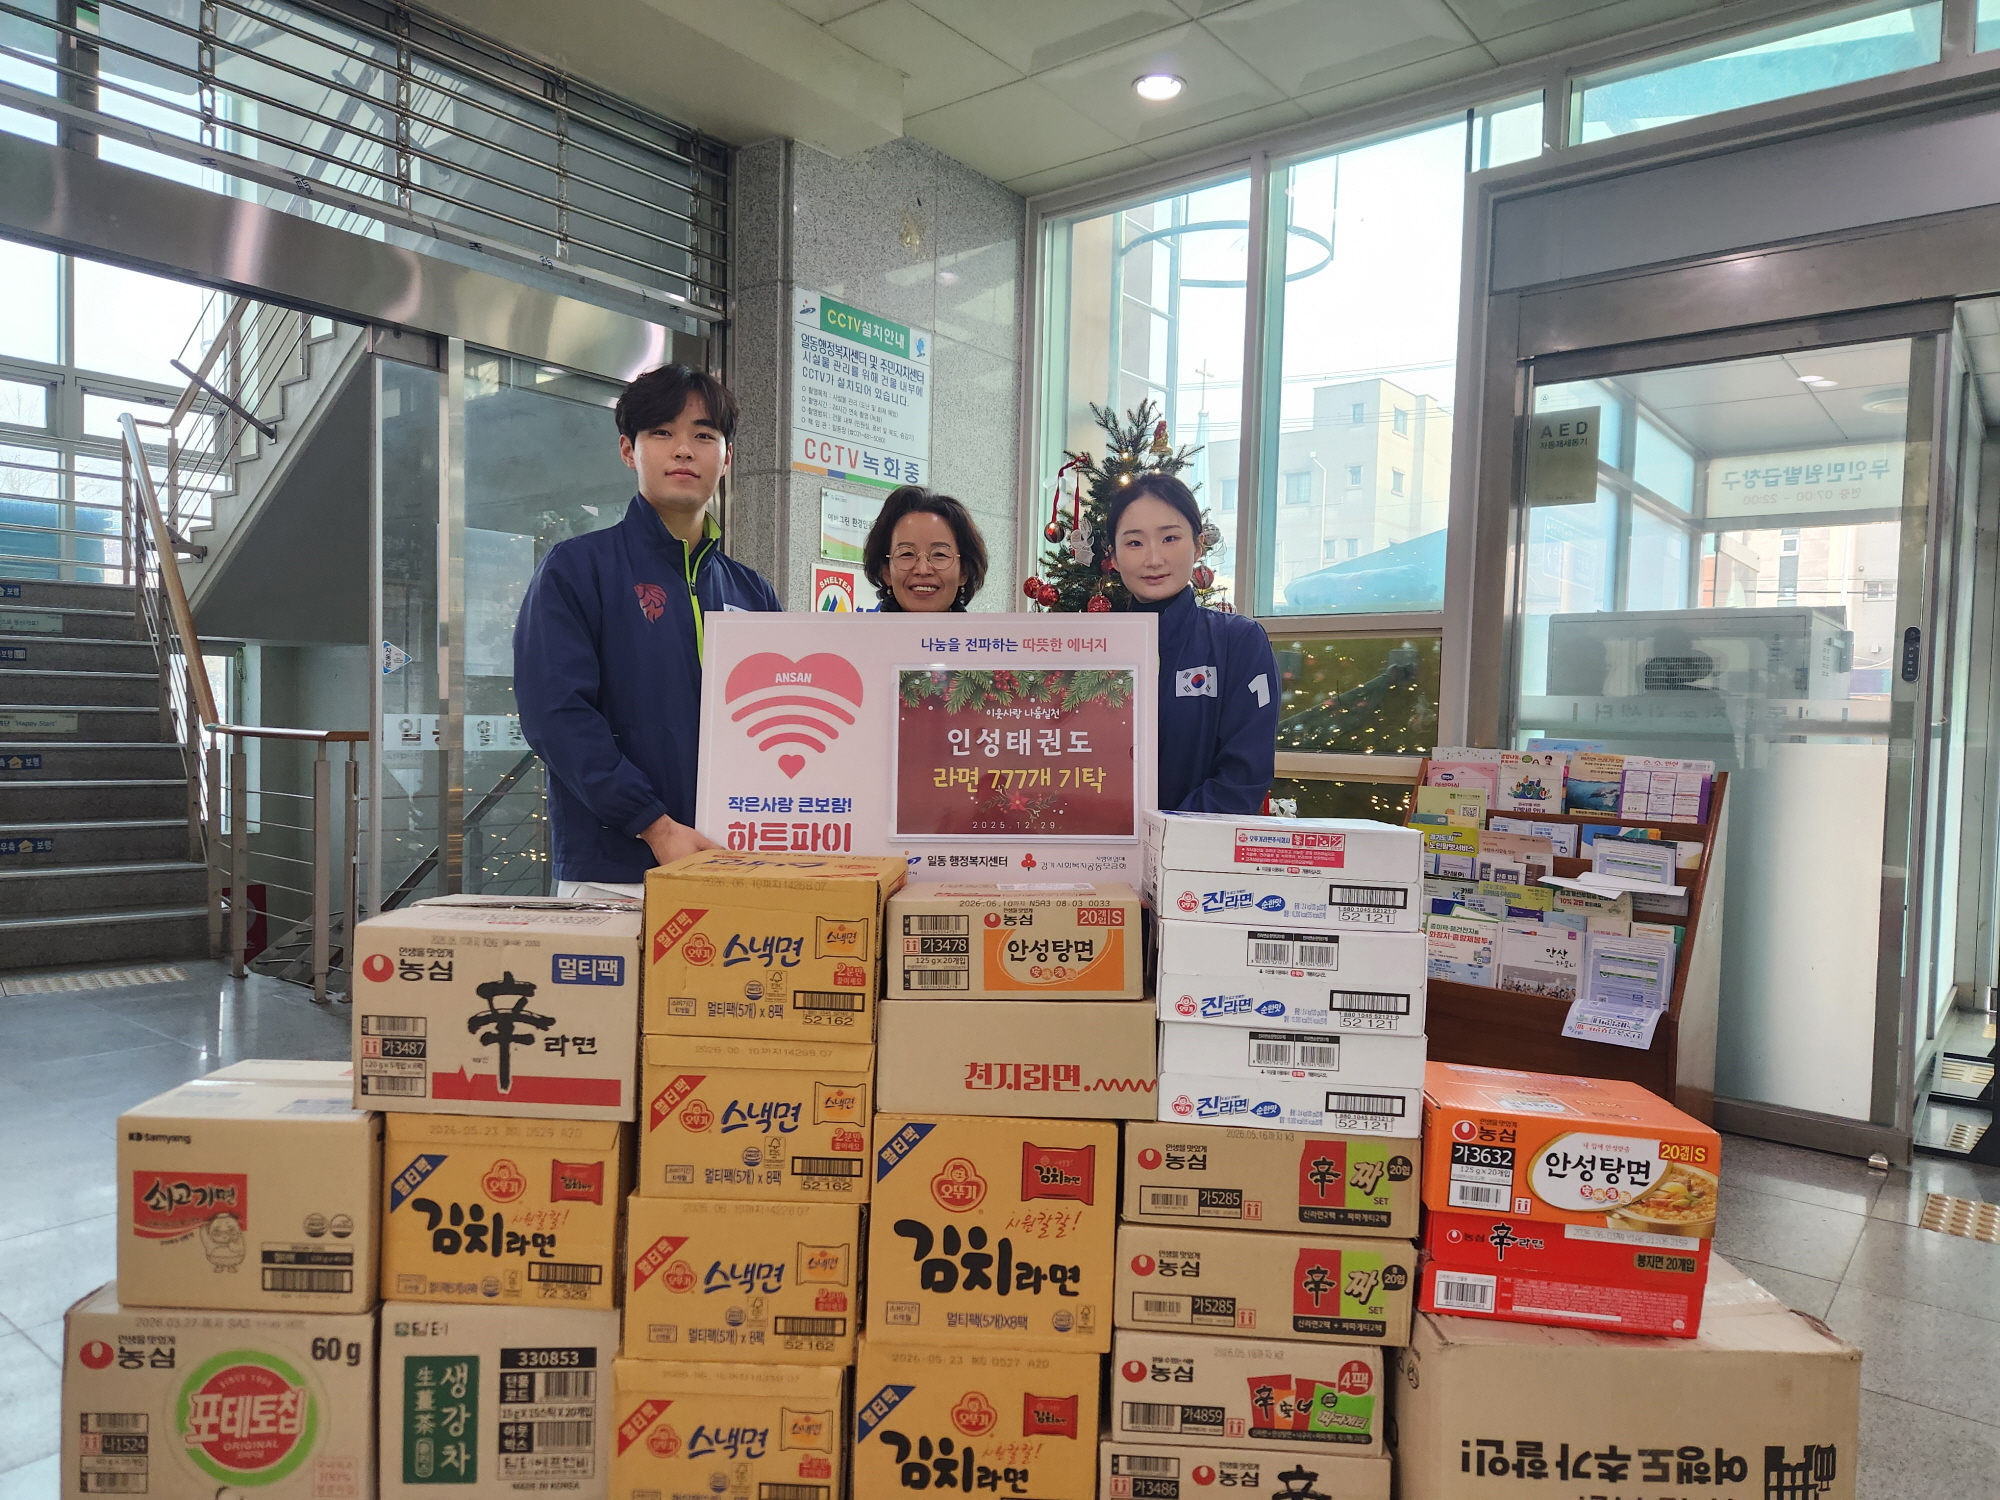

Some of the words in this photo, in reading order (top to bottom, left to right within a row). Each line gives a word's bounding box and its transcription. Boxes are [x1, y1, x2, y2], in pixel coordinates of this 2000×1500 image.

[827, 309, 905, 349] CCTV설치안내
[801, 333, 867, 366] 일동행정복지센터
[870, 357, 878, 370] 및
[880, 358, 924, 385] 주민자치센터
[803, 352, 830, 369] 시설물
[833, 360, 858, 377] 관리를
[862, 369, 878, 382] 위해
[881, 375, 897, 390] 건물
[900, 380, 923, 397] 내부에
[802, 367, 834, 385] CCTV가
[837, 376, 872, 396] 설치되어
[874, 391, 909, 407] 있습니다.
[804, 438, 859, 469] CCTV
[827, 512, 850, 526] 에버그린
[819, 576, 852, 594] SHELTER
[921, 638, 961, 652] 나눔을
[965, 638, 1018, 652] 전파하는
[1023, 638, 1063, 652] 따뜻한
[1067, 638, 1107, 652] 에너지
[775, 672, 812, 684] ANSAN
[1248, 673, 1271, 708] 1
[986, 708, 1022, 720] 이웃사랑
[948, 728, 1093, 758] 인성태권도
[933, 766, 980, 793] 라면
[987, 767, 1051, 789] 777개
[1059, 766, 1106, 794] 기탁
[728, 796, 794, 813] 작은사랑
[798, 797, 852, 813] 큰보람!
[728, 821, 851, 852] 하트파이
[927, 856, 947, 867] 일동
[949, 855, 1008, 868] 행정복지센터
[1202, 888, 1254, 914] 진라면
[1261, 898, 1283, 909] 순한맛
[1003, 914, 1033, 926] 농심
[1341, 912, 1360, 921] 52
[1366, 914, 1391, 922] 121
[656, 912, 693, 949] 멀티팩
[826, 930, 858, 945] 스낵면
[687, 947, 711, 960] 오뚜기
[723, 934, 804, 968] 스낵면
[923, 938, 967, 953] 가3478
[1007, 939, 1094, 963] 안성탕면
[1546, 947, 1568, 960] 안산
[398, 958, 453, 982] 농심
[558, 958, 619, 982] 멀티팩
[707, 1001, 757, 1018] 멀티팩(5개)
[768, 1004, 784, 1019] 8팩
[1200, 993, 1253, 1018] 진라면
[1261, 1003, 1283, 1014] 순한맛
[468, 971, 556, 1091] 辛
[383, 1041, 426, 1056] 가3487
[544, 1035, 597, 1057] 라면
[655, 1078, 691, 1116] 멀티팩
[1196, 1094, 1248, 1118] 진라면
[685, 1114, 708, 1126] 오뚜기
[721, 1100, 802, 1134] 스낵면
[1256, 1104, 1278, 1116] 순한맛
[881, 1126, 920, 1166] 멀티팩
[1479, 1127, 1516, 1143] 농심
[1165, 1152, 1207, 1170] 농심
[1454, 1145, 1513, 1166] 가3632
[394, 1157, 432, 1197] 멀티팩
[705, 1168, 755, 1185] 멀티팩(5개)
[766, 1170, 781, 1186] 8팩
[1035, 1165, 1081, 1186] 김치라면
[1309, 1156, 1342, 1198] 辛
[1350, 1161, 1384, 1196] 짜
[1546, 1152, 1651, 1186] 안성탕면
[143, 1180, 238, 1212] 쇠고기면
[489, 1181, 519, 1194] 오뚜기
[940, 1183, 977, 1199] 오뚜기
[1201, 1191, 1240, 1205] 가5285
[1374, 1197, 1389, 1206] SET
[412, 1198, 555, 1258] 김치라면
[1005, 1206, 1082, 1239] 시원칼칼!
[1464, 1232, 1485, 1243] 농심
[1489, 1223, 1518, 1261] 辛
[1518, 1237, 1545, 1249] 라면
[637, 1239, 673, 1276] 멀티팩
[894, 1219, 1080, 1296] 김치라면
[1158, 1259, 1200, 1277] 농심
[1637, 1254, 1664, 1269] 봉지면
[1666, 1257, 1695, 1272] 20개입
[704, 1261, 785, 1295] 스낵면
[1303, 1265, 1336, 1307] 辛
[1345, 1269, 1379, 1305] 짜
[543, 1288, 558, 1298] 72
[1194, 1299, 1234, 1313] 가5285
[1368, 1306, 1384, 1315] SET
[117, 1347, 175, 1369] 농심
[311, 1337, 341, 1361] 60
[346, 1340, 361, 1367] g
[518, 1352, 580, 1366] 330853
[1151, 1364, 1194, 1383] 농심
[1341, 1371, 1369, 1390] 4팩
[1254, 1385, 1274, 1420] 辛
[184, 1389, 306, 1444] 포테토칩
[440, 1362, 472, 1477] 생강차
[1183, 1408, 1224, 1423] 가4859
[223, 1440, 278, 1450] ORIGINAL
[688, 1425, 769, 1459] 스낵면
[880, 1431, 1029, 1493] 김치라면
[1461, 1439, 1631, 1483] 추가할인!
[1638, 1446, 1748, 1485] 여행도
[1134, 1480, 1177, 1496] 가3486
[1219, 1469, 1259, 1487] 농심
